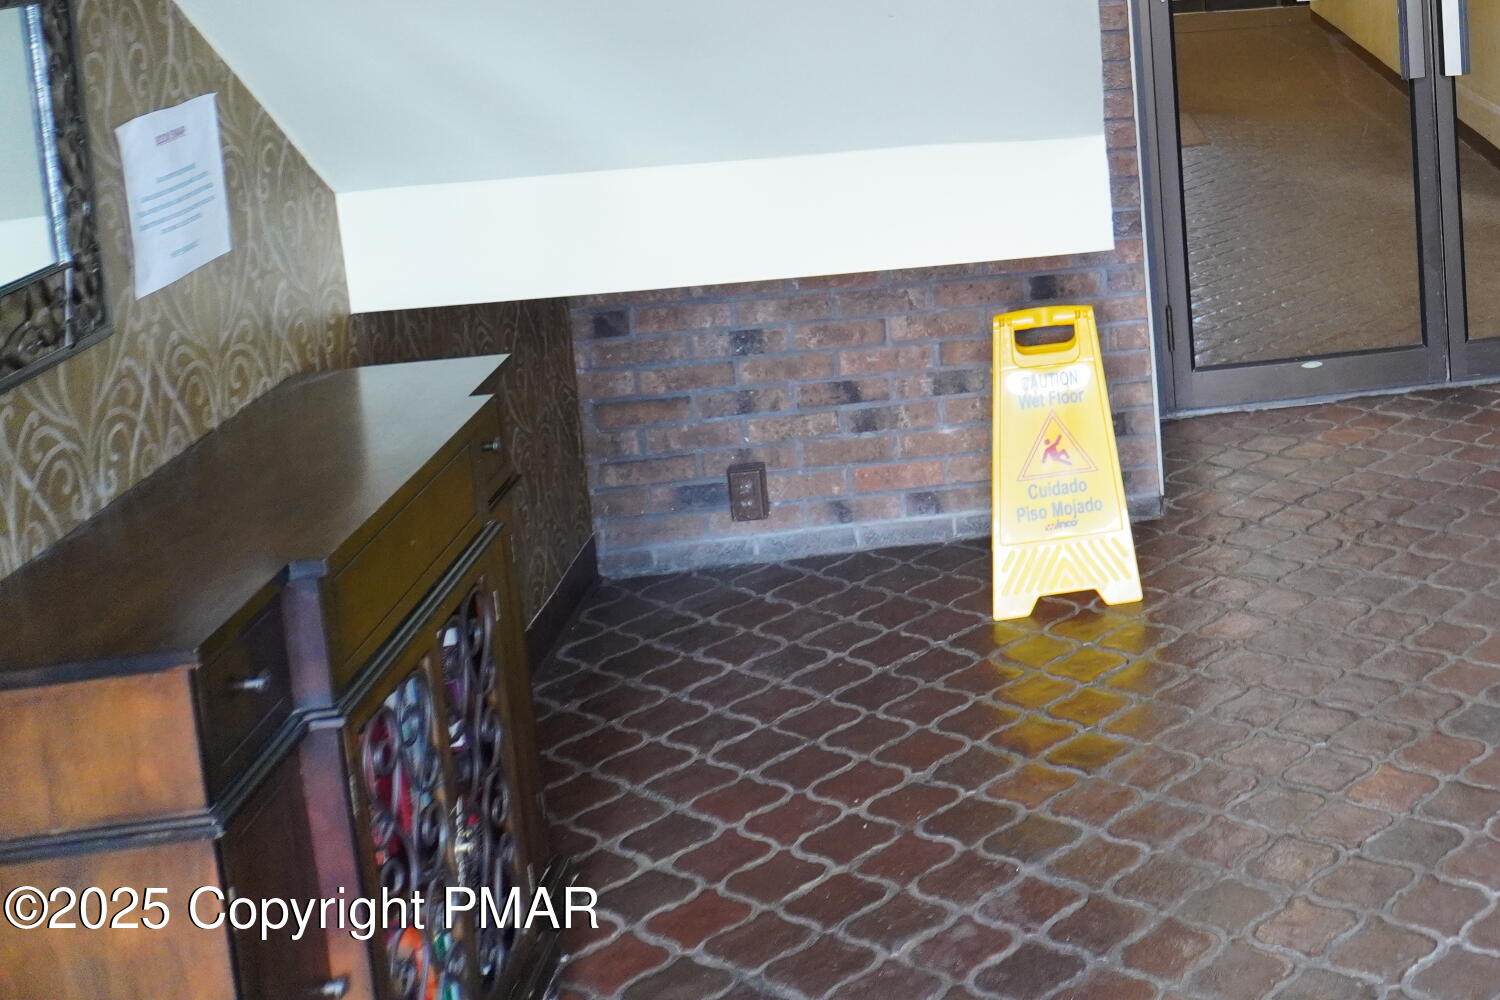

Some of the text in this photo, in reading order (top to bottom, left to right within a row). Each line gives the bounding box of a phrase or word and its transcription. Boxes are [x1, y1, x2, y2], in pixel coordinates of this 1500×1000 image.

[1021, 370, 1078, 390] CAUTION
[1018, 389, 1085, 410] Wet Floor
[1027, 478, 1088, 500] Cuidado
[1016, 496, 1103, 523] Piso Mojado
